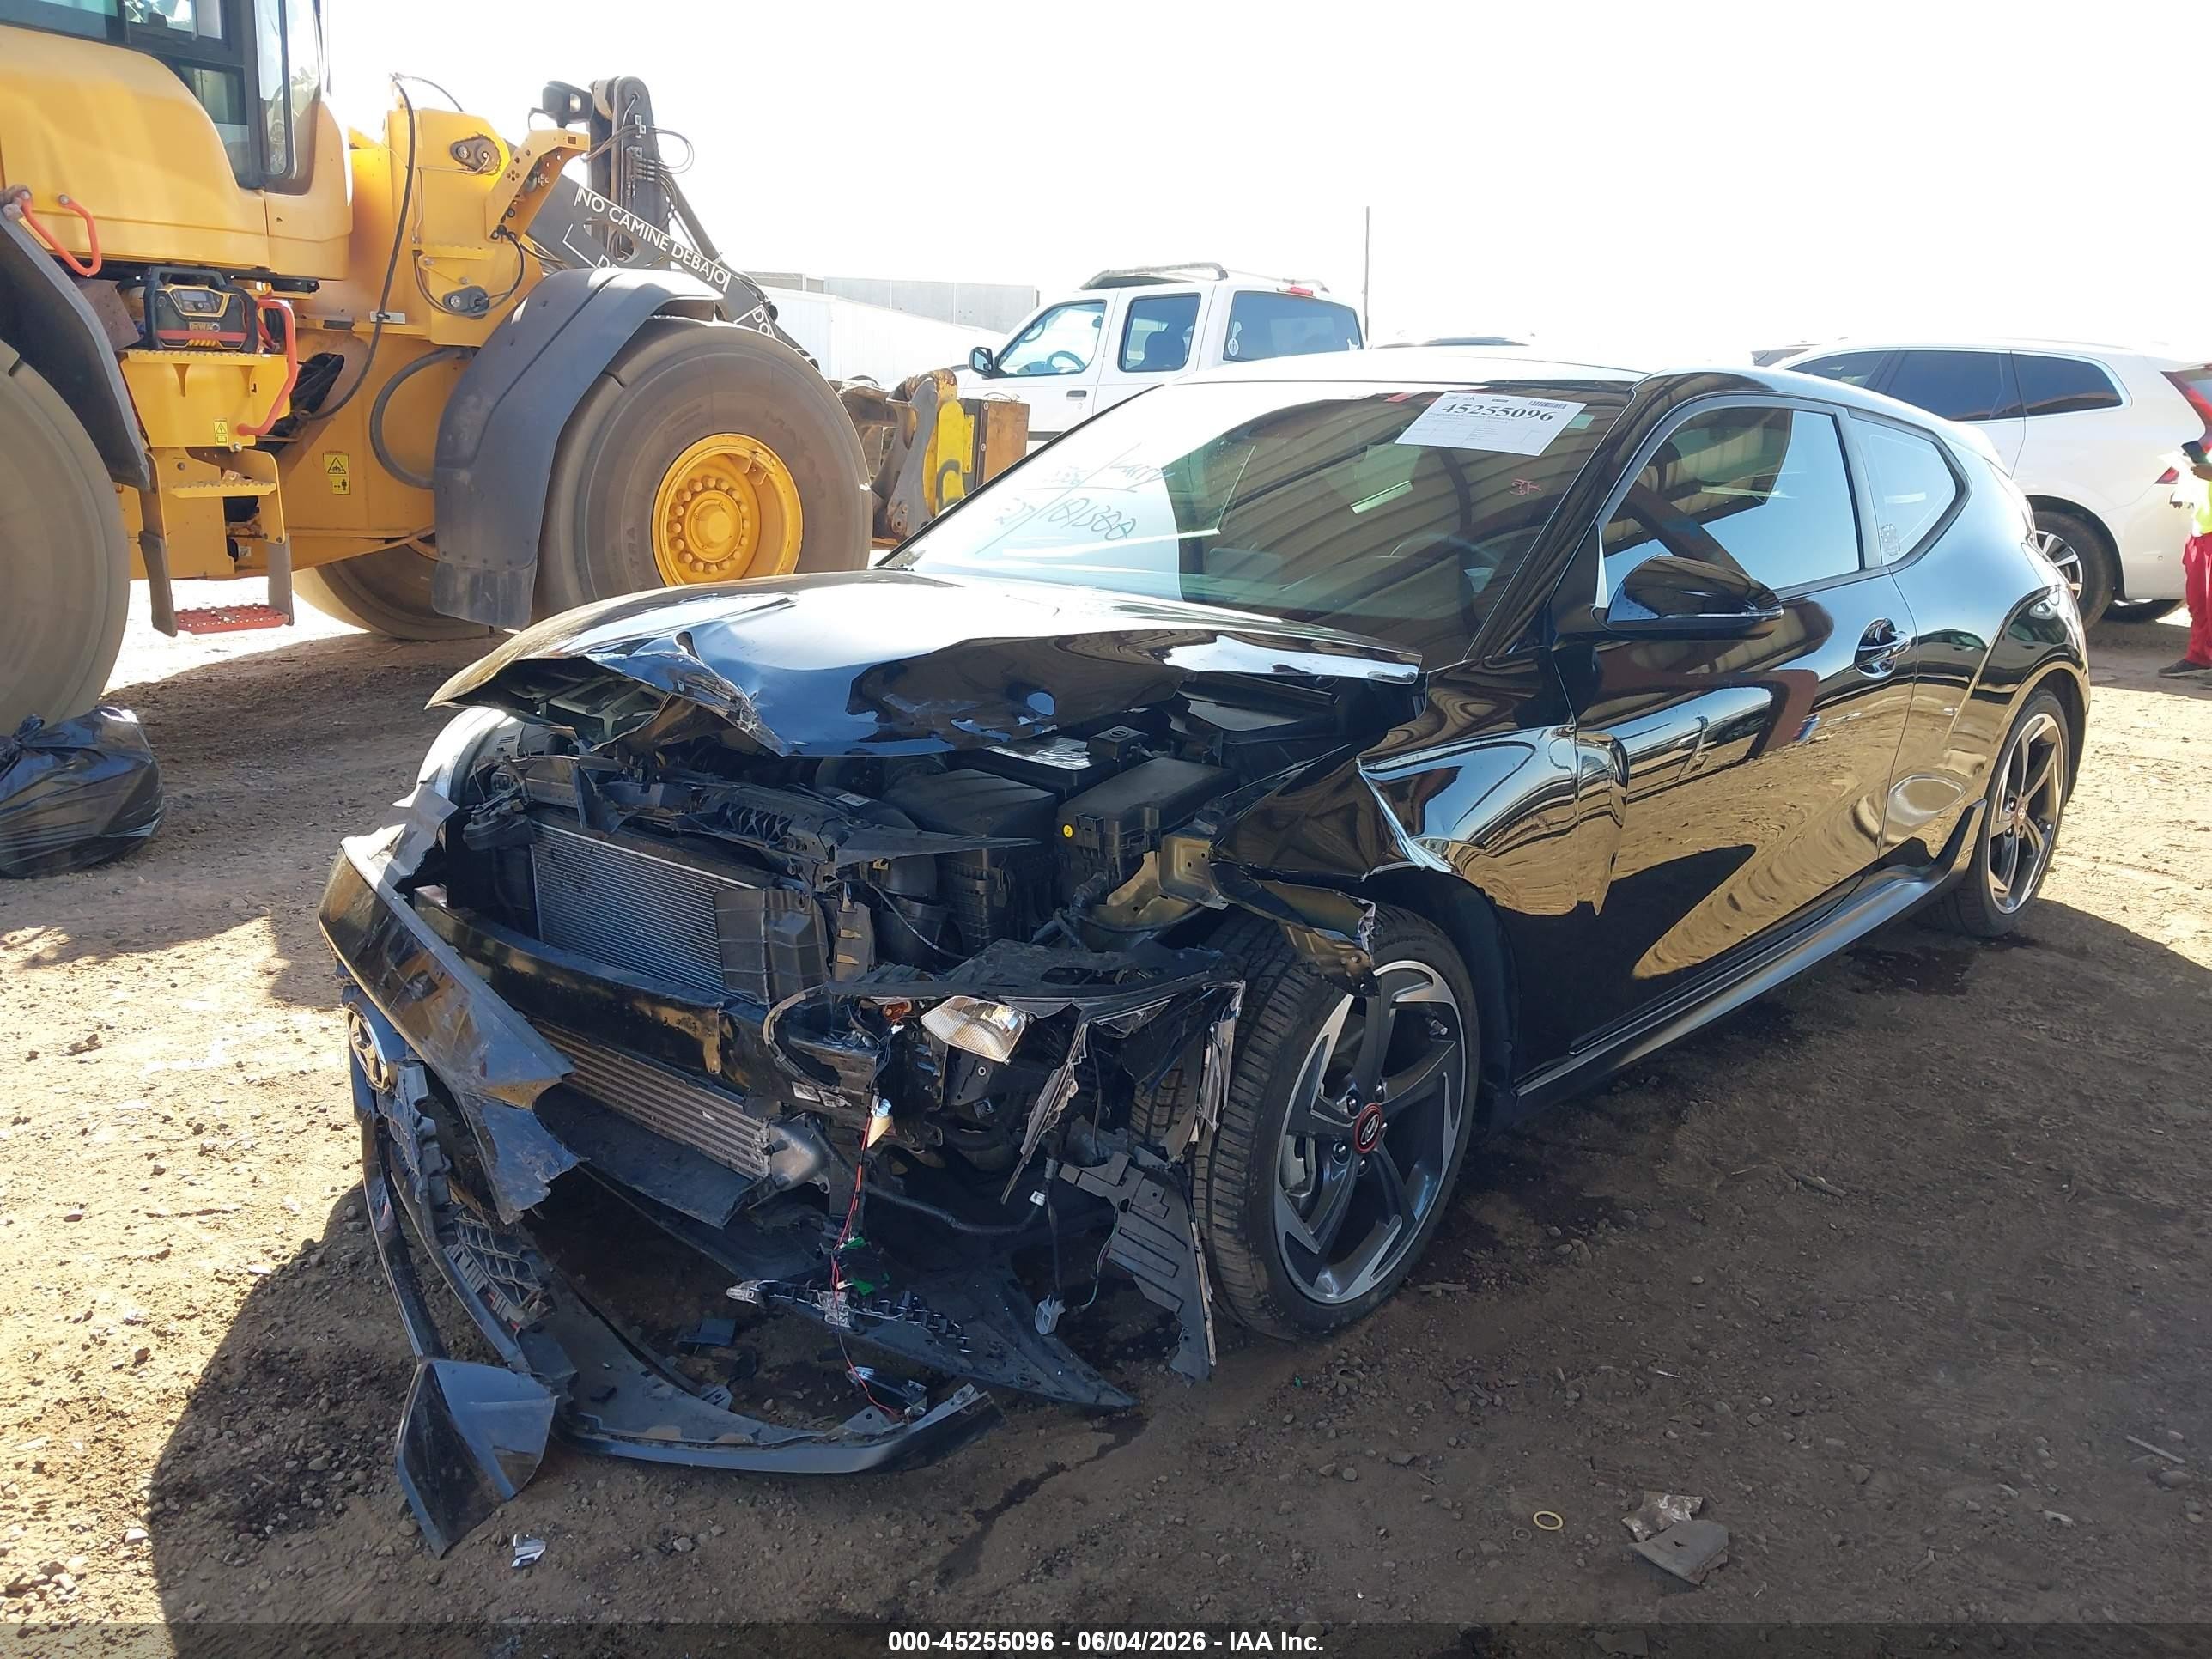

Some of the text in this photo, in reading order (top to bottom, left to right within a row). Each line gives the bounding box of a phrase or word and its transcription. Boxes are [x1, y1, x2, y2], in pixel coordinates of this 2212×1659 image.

[577, 188, 726, 284] NO CAMINE DEBAJO
[1442, 404, 1557, 422] 45255096
